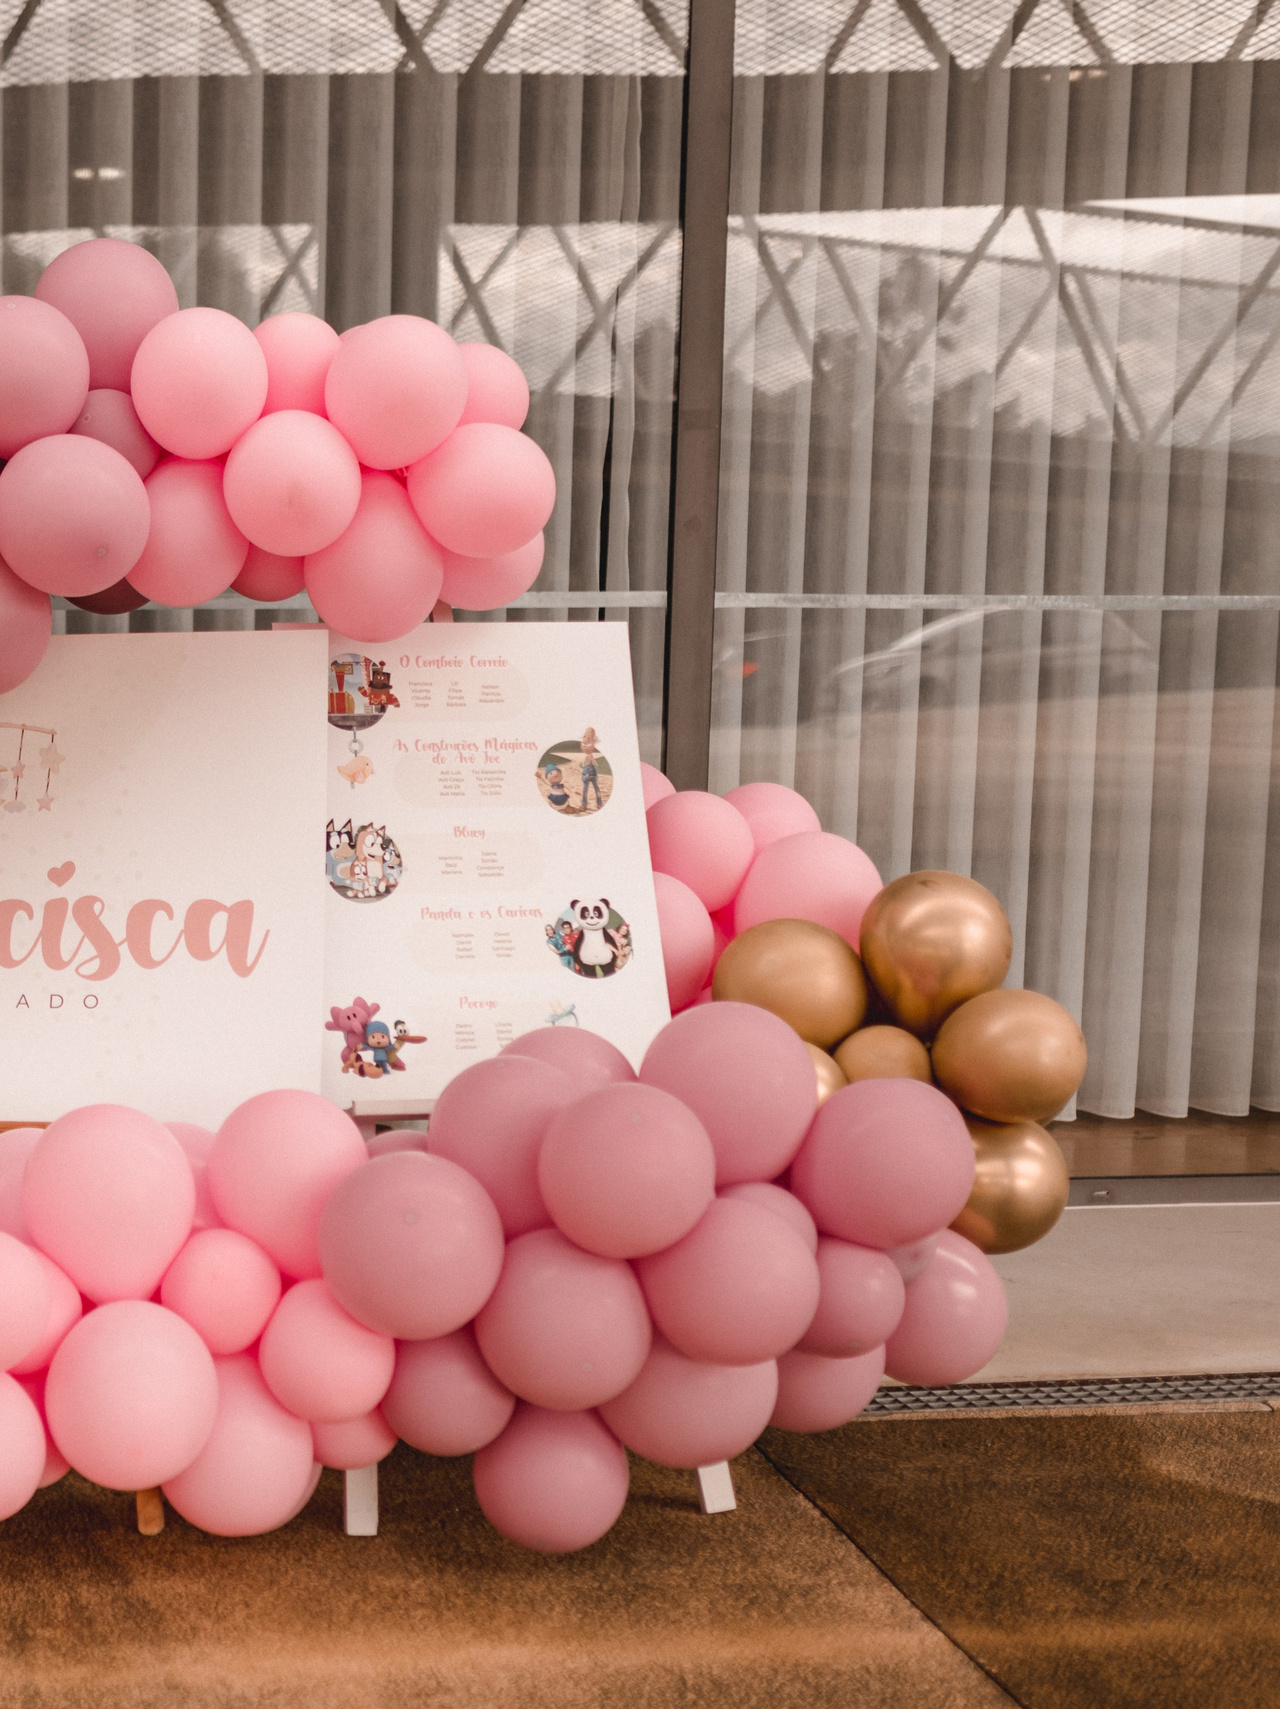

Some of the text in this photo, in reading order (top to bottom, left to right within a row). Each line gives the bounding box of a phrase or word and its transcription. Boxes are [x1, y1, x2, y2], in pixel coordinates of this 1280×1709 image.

[399, 654, 508, 670] O Comboio Correio
[393, 737, 538, 754] As Construções Mágicas
[432, 752, 447, 765] do
[482, 751, 501, 765] Joe
[453, 826, 486, 839] Bluey
[420, 906, 543, 921] Panda e os Caricas
[459, 996, 498, 1010] Pocoyo
